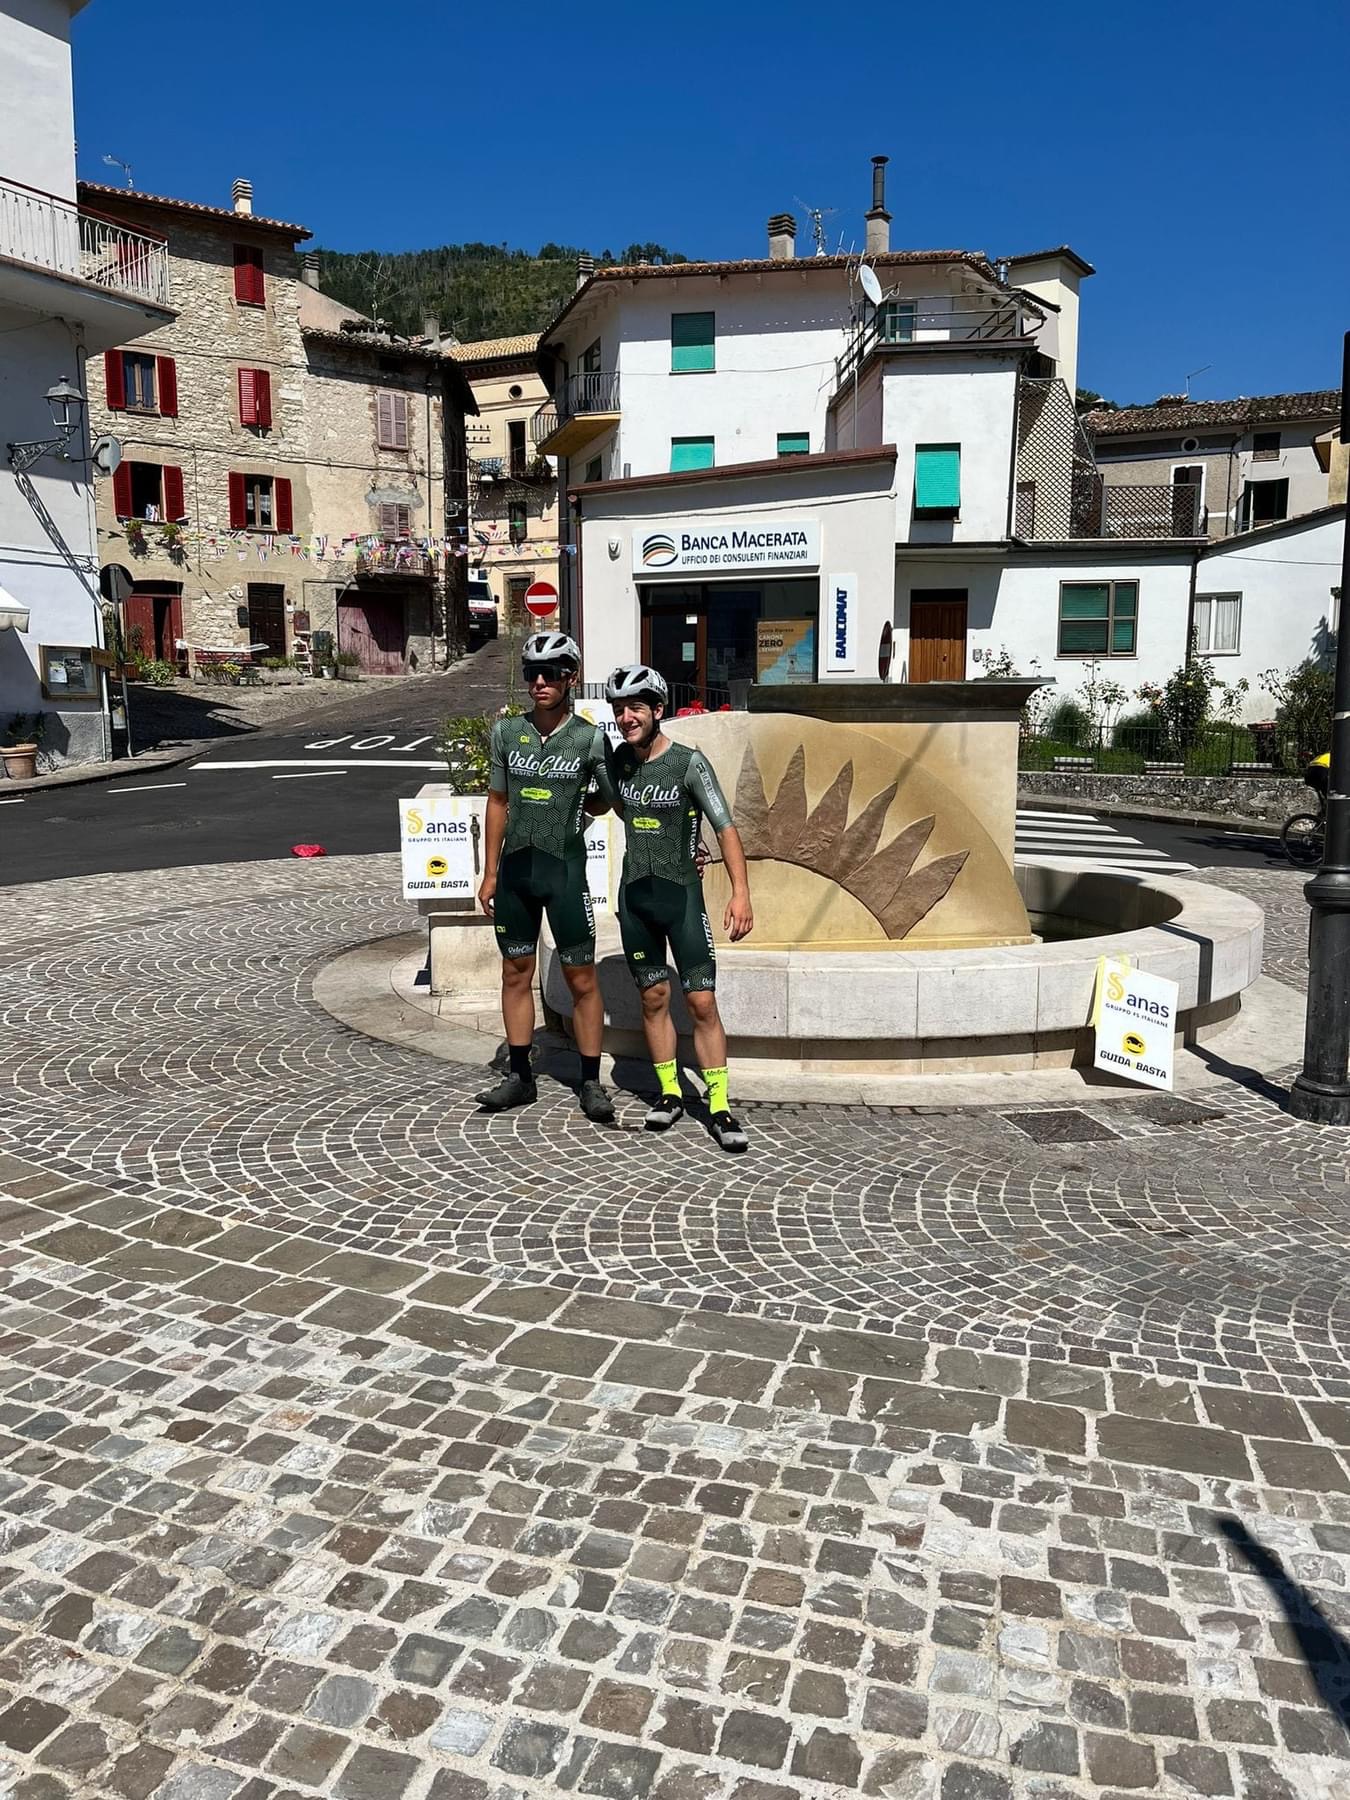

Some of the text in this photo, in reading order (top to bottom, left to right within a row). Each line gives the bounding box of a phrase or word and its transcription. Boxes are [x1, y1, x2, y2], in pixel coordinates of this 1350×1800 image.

[681, 531, 808, 551] BANCA MACERATA
[681, 550, 808, 565] UFFICIO DEI CONSULENTI FINANZIARI
[836, 587, 847, 659] BANCOMAT
[758, 639, 784, 647] ZERO
[598, 721, 617, 731] an
[426, 822, 467, 834] anas
[587, 839, 606, 851] as
[407, 881, 436, 889] GUIDA
[441, 880, 469, 889] BASTA
[591, 896, 607, 904] STA
[1126, 993, 1170, 1018] anas
[1105, 1002, 1132, 1015] GRUPPO
[1141, 1014, 1168, 1028] ITALIANE
[1100, 1050, 1131, 1067] GUIDA
[1136, 1061, 1167, 1079] BASTA
